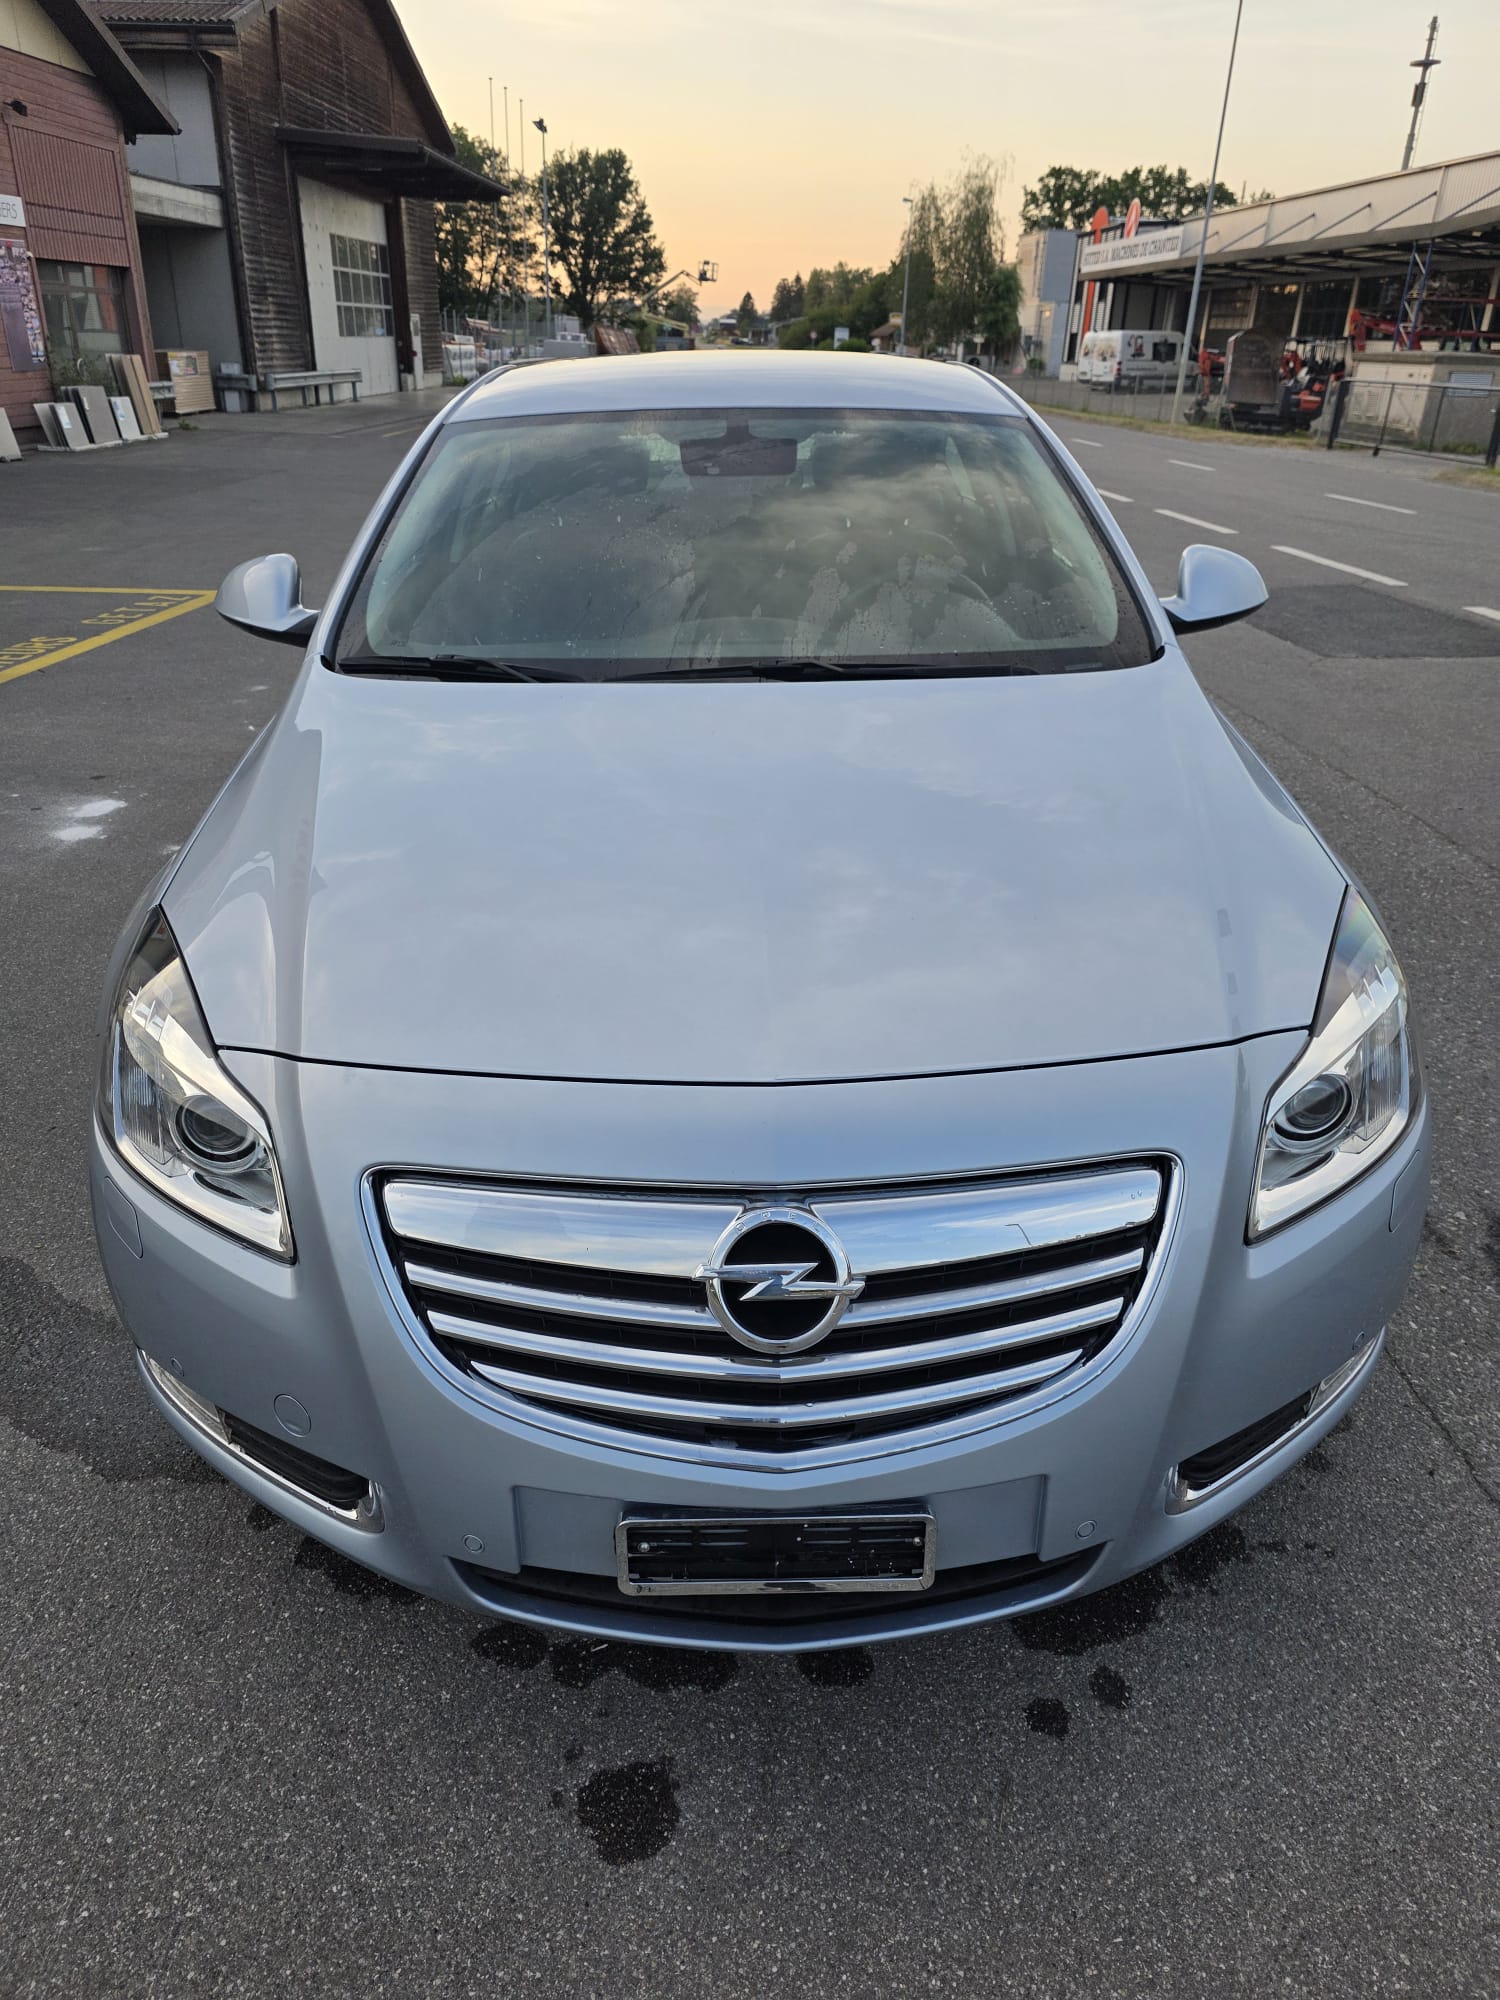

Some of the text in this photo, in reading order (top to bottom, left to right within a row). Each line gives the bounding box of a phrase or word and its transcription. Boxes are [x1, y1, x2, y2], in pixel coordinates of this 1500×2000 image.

[0, 202, 17, 219] ERS
[1112, 244, 1140, 261] MACHINES
[1140, 241, 1148, 258] DE
[1149, 236, 1180, 256] CHANTIER
[0, 594, 191, 669] EURS GETAZ
[736, 1211, 821, 1233] OPEL
